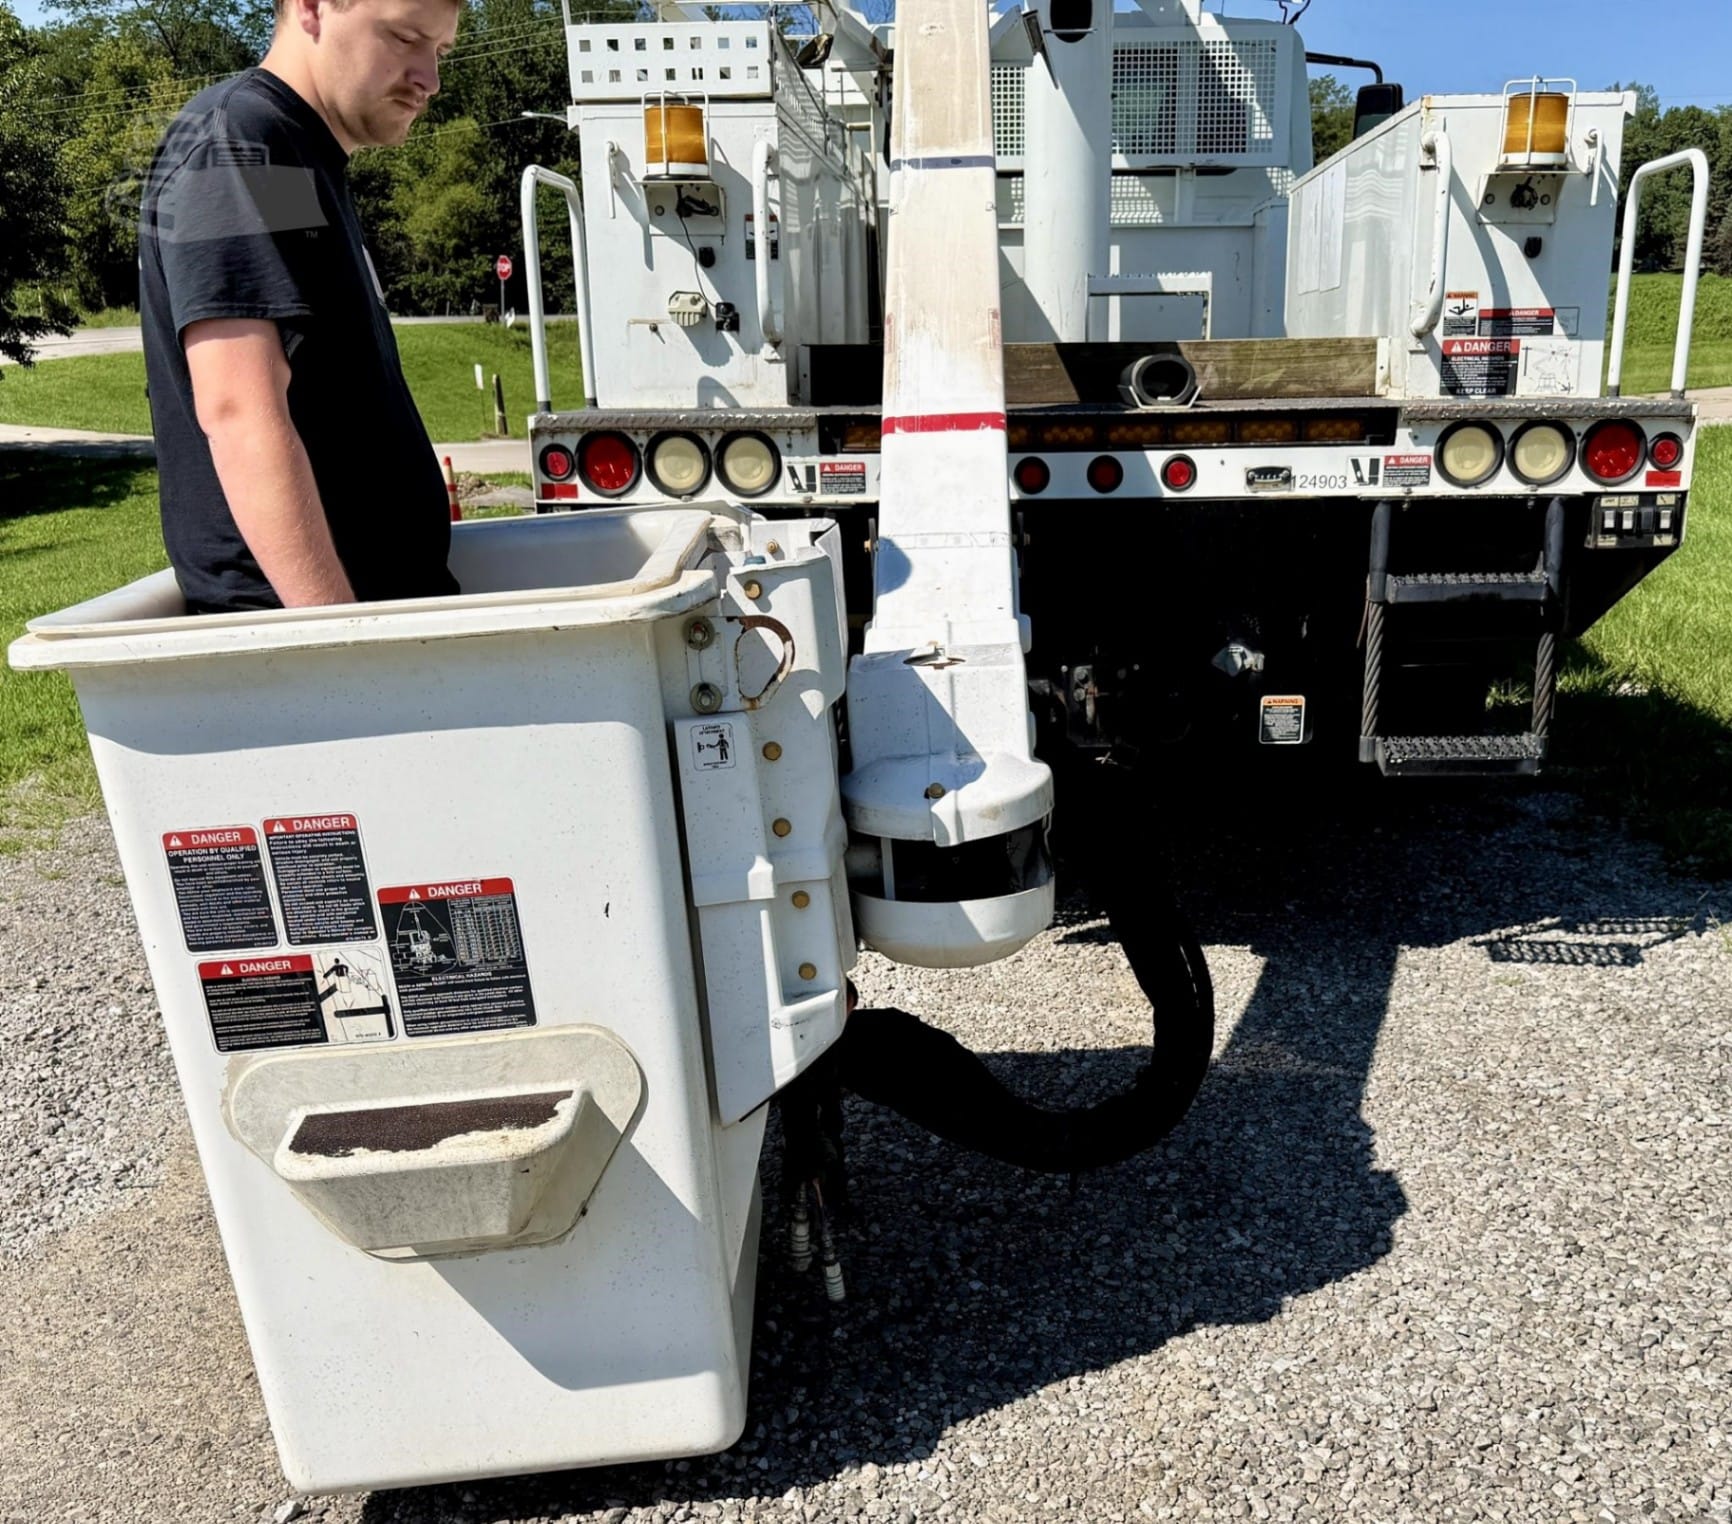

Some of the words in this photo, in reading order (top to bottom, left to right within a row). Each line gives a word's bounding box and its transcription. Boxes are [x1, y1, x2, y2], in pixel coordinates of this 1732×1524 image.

[1464, 341, 1511, 352] DANGER
[1400, 456, 1428, 464] DANGER
[1291, 474, 1347, 489] 124903
[292, 816, 351, 831] DANGER
[190, 831, 241, 845] DANGER
[168, 848, 208, 858] OPERATION
[209, 847, 219, 855] BY
[220, 845, 257, 854] QUALIFIED
[183, 854, 225, 863] PERSONNEL
[427, 882, 483, 898] DANGER
[239, 959, 291, 974] DANGER
